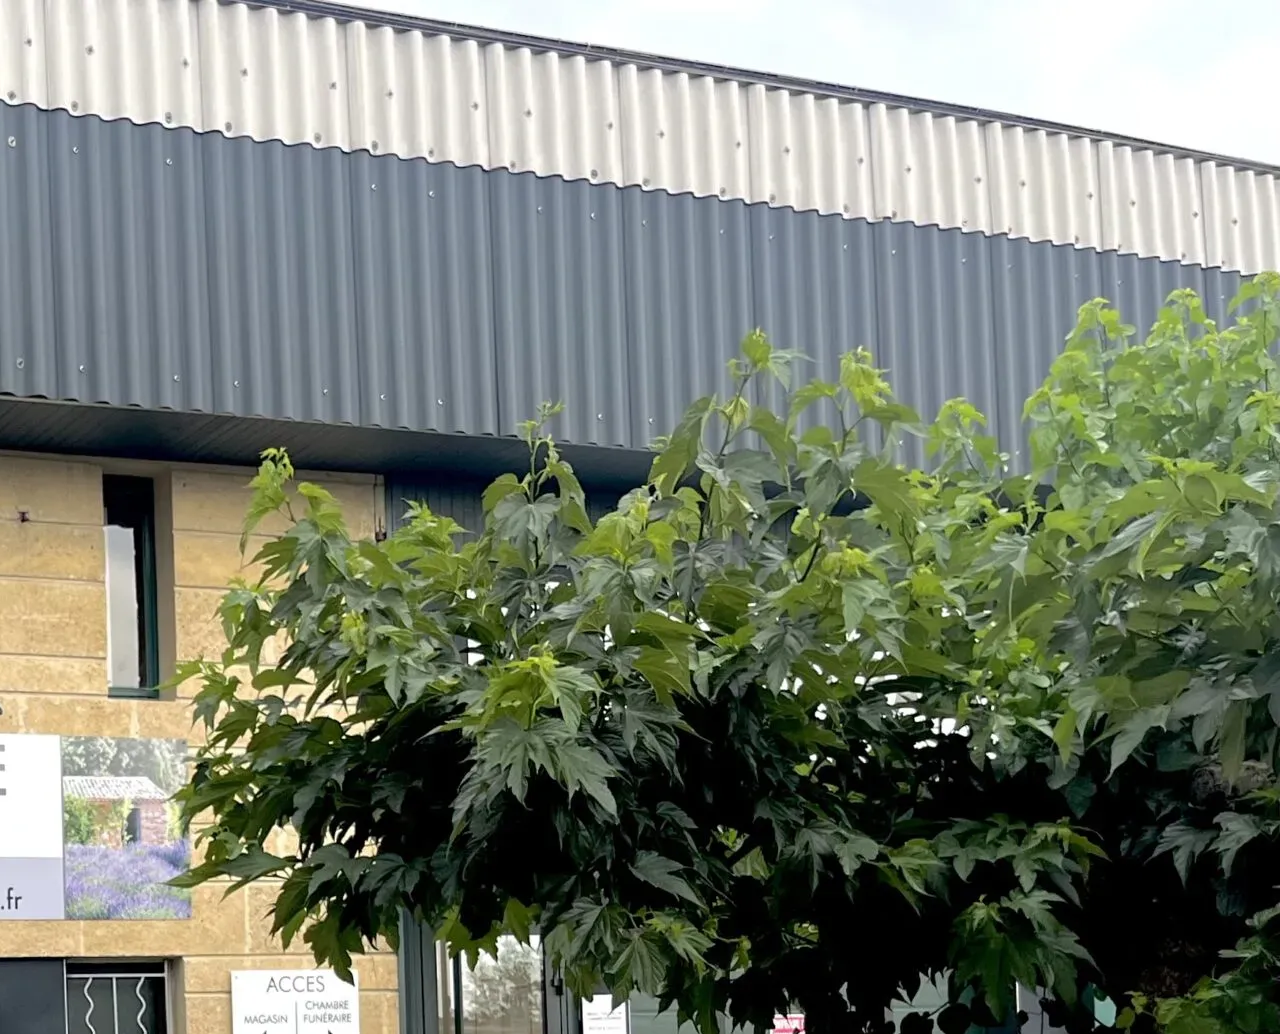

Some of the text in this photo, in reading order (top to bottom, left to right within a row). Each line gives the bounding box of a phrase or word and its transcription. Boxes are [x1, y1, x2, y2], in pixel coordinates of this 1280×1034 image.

[267, 976, 325, 992] ACCES
[305, 1000, 349, 1010] CHAMBRE
[244, 1015, 288, 1024] MAGASIN
[304, 1012, 351, 1023] FUNÉRAIRE
